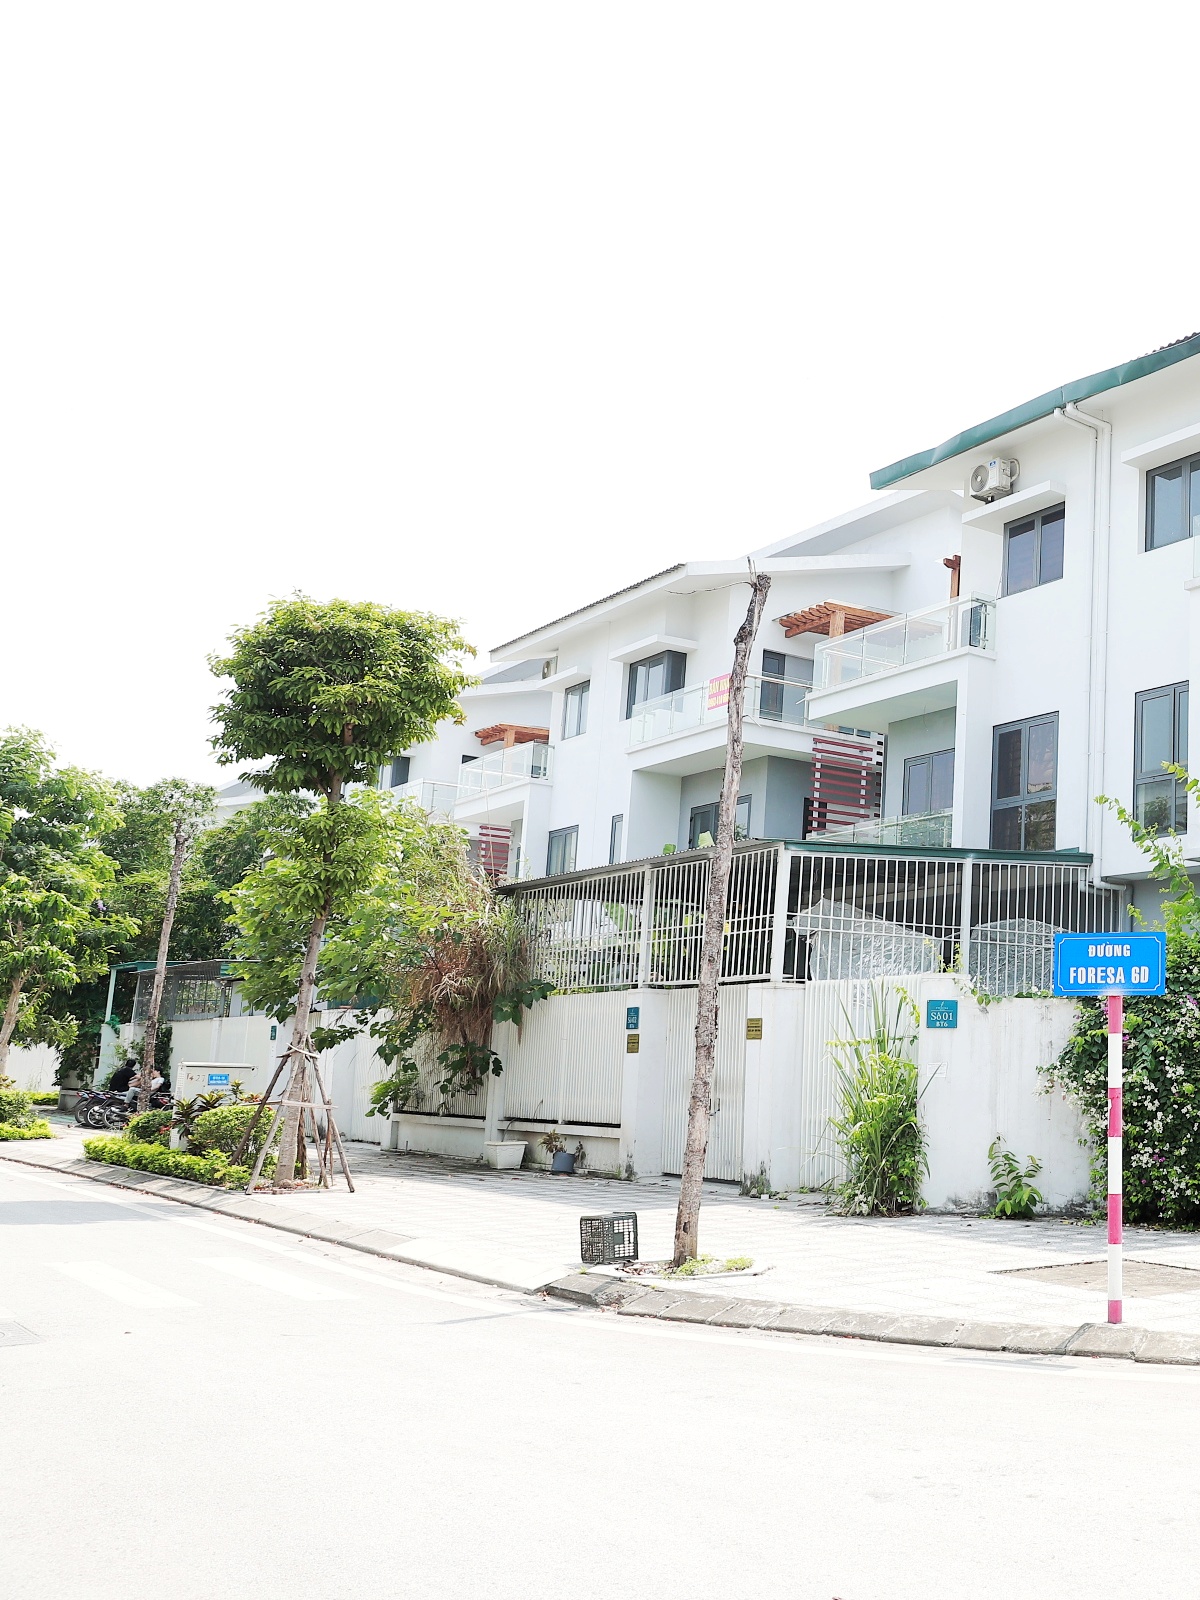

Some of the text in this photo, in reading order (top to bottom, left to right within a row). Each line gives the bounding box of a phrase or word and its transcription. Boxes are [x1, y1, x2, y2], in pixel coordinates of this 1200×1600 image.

[1088, 941, 1131, 958] ĐƯỜNG
[1069, 966, 1150, 984] FORESA 6D
[942, 1011, 954, 1021] 01
